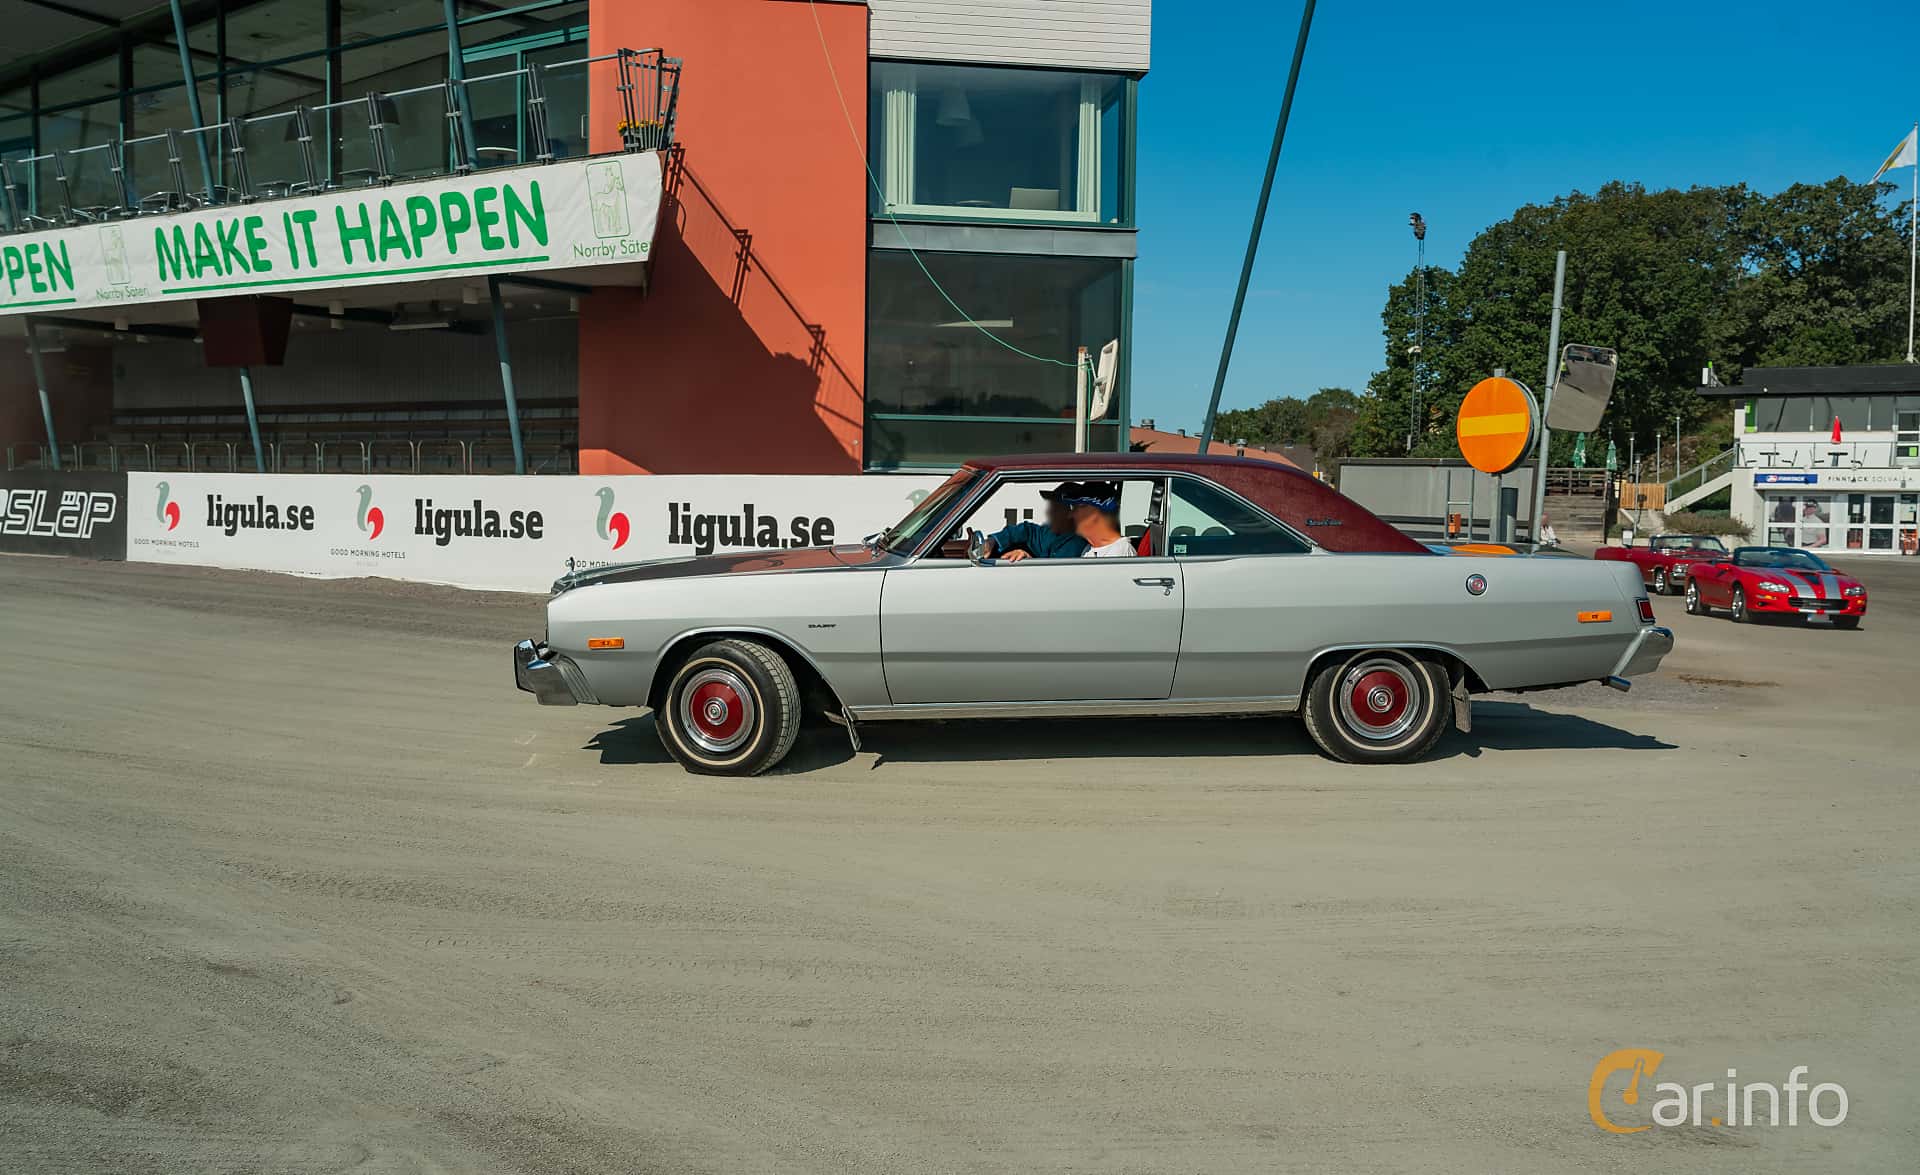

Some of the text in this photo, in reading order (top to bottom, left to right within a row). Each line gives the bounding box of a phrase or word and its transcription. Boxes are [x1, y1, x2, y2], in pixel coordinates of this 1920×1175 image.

[154, 180, 549, 283] MAKE IT HAPPEN
[573, 240, 616, 260] Norrby
[0, 239, 76, 297] PEN
[206, 493, 316, 537] ligula.se
[414, 498, 544, 547] ligula.se
[668, 501, 836, 557] ligula.se
[330, 547, 406, 559] GOOD MORNING HOTELS
